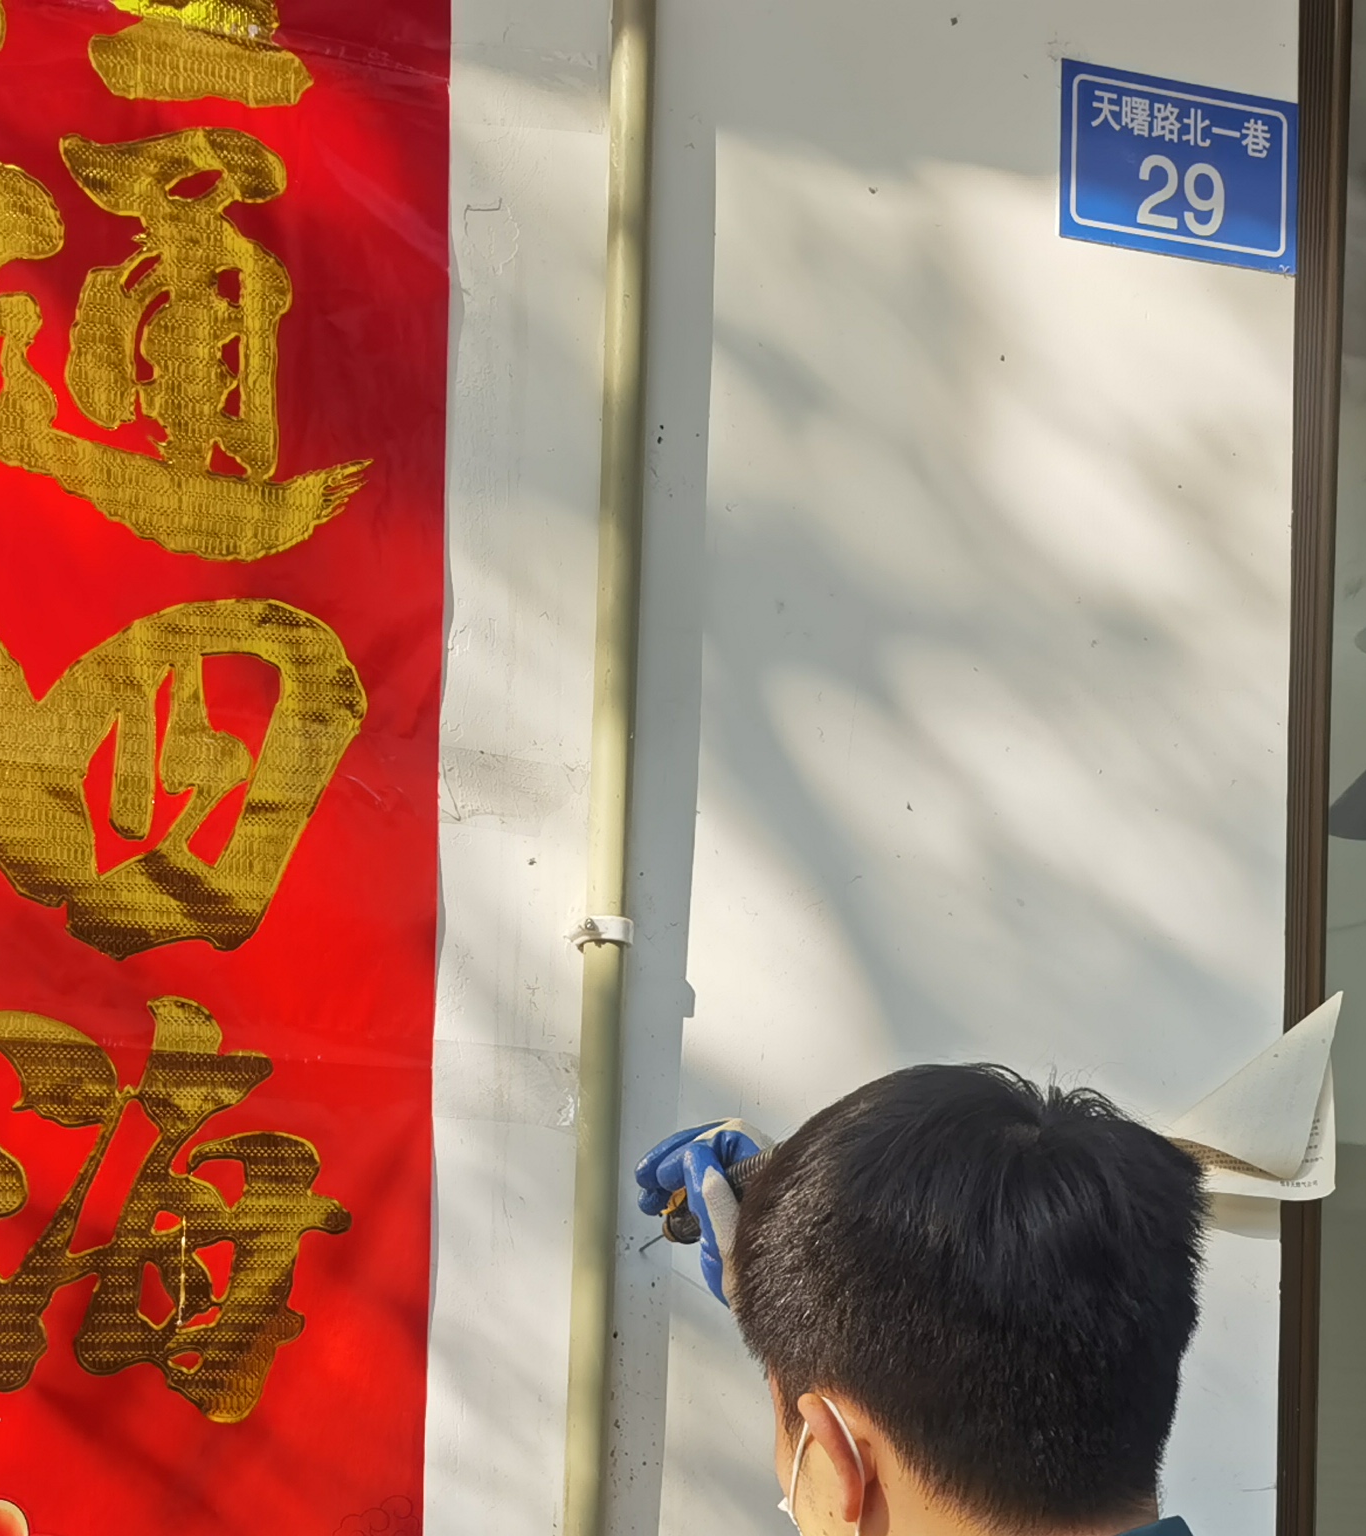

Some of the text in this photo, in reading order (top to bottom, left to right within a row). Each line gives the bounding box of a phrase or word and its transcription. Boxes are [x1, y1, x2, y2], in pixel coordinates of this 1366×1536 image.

[1090, 90, 1272, 158] 天曙路北一巷
[1136, 154, 1225, 236] 29
